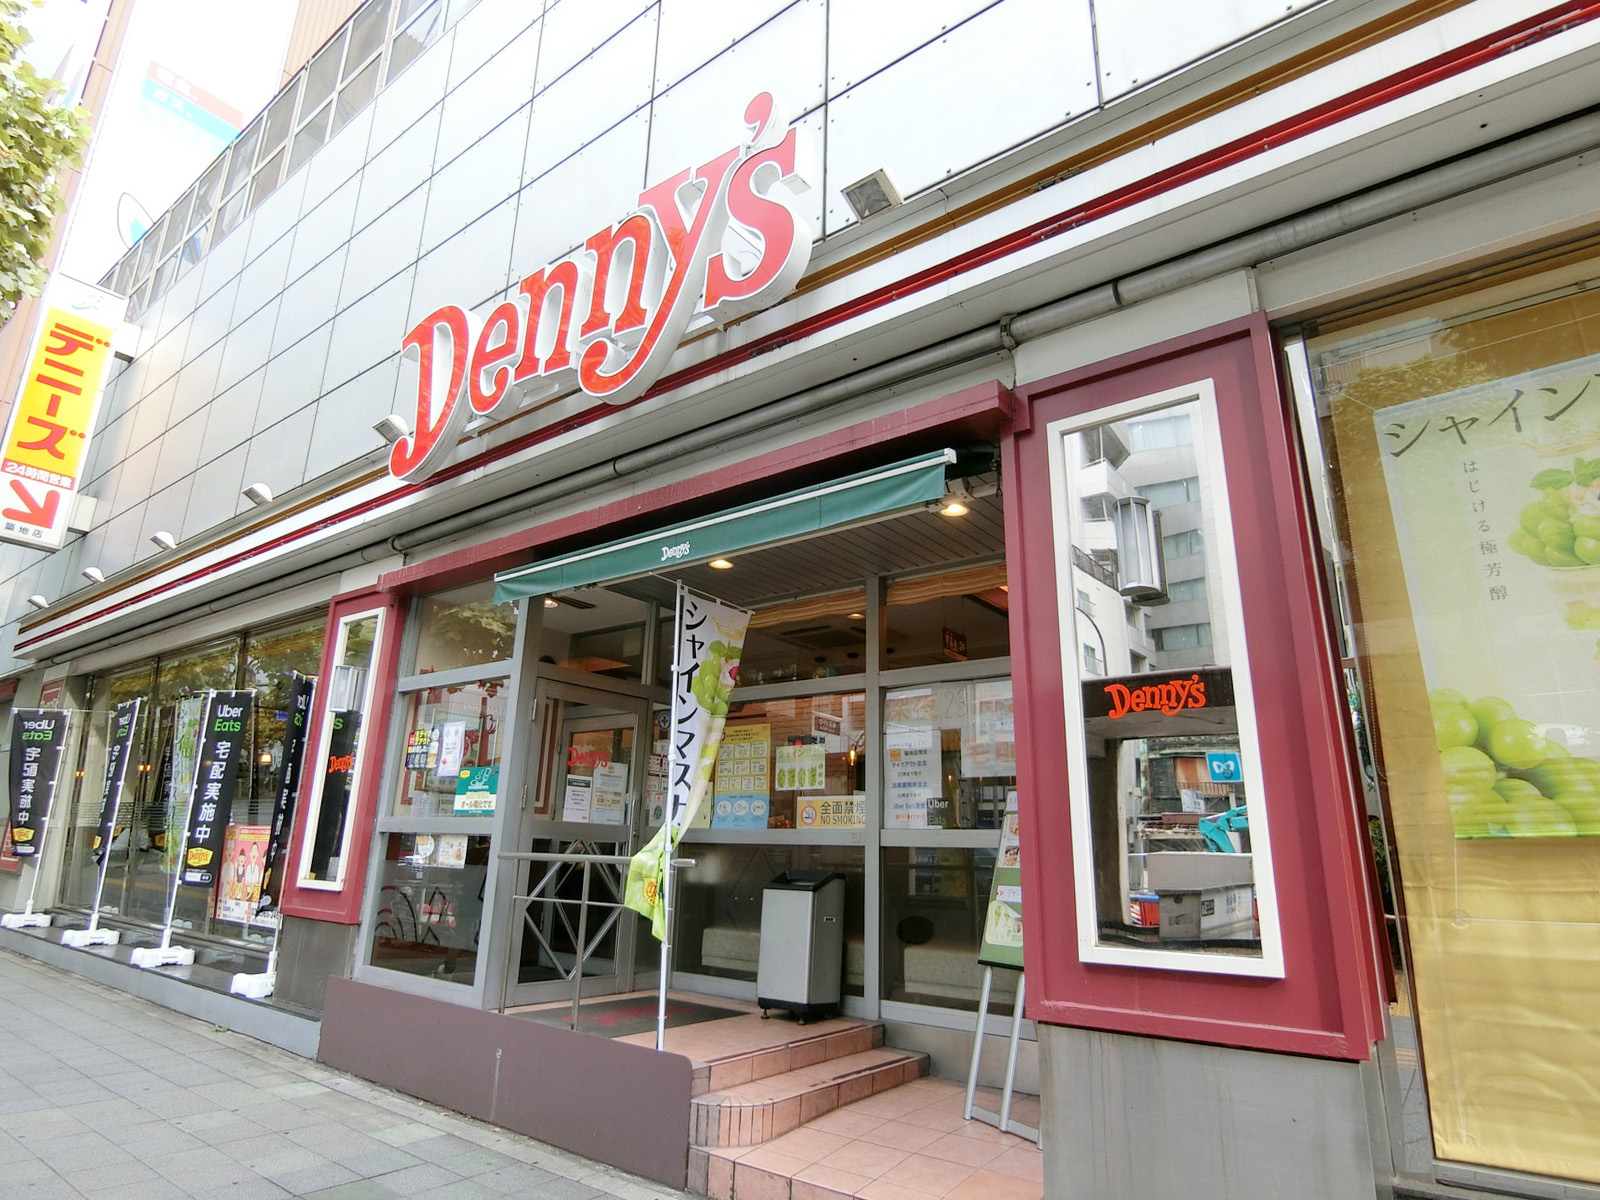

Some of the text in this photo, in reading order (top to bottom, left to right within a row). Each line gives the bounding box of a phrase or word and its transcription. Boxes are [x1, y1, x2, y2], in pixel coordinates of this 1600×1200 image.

[389, 91, 808, 480] Denny's
[17, 322, 111, 460] デニーズ
[1384, 373, 1600, 458] シャイン
[4, 461, 73, 488] 24時間営業
[4, 521, 44, 539] 築地店
[1462, 459, 1509, 601] はじける極芳醇
[661, 540, 691, 562] Denny's
[1104, 674, 1206, 720] Denny's
[217, 704, 244, 718] Uber
[214, 718, 242, 732] Eats
[567, 746, 608, 770] Denny's
[194, 740, 232, 844] 宅配実施中
[927, 798, 949, 809] Uber
[820, 800, 866, 815] 全面禁煙
[928, 813, 948, 825] Eats
[820, 815, 830, 825] NO
